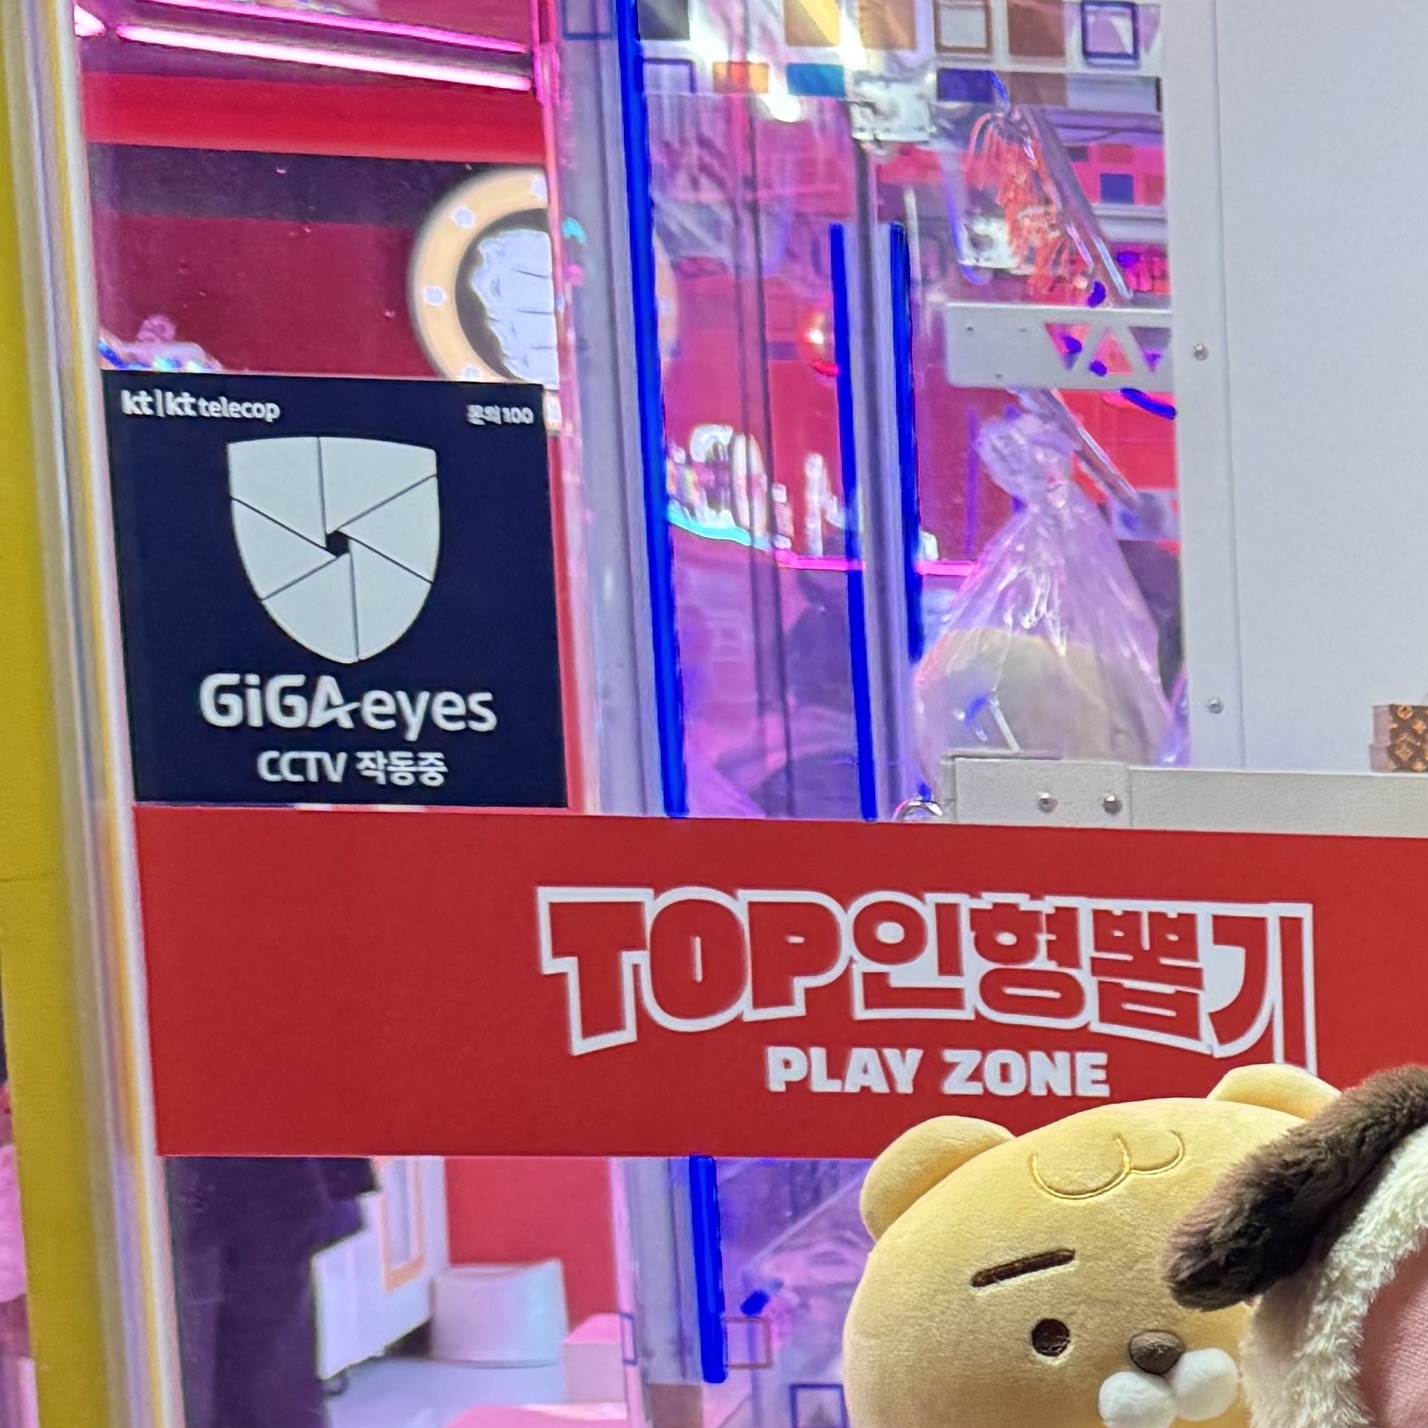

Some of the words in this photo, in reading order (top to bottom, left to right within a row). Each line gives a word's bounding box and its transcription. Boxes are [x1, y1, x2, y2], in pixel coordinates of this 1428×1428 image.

[256, 750, 348, 783] CCTV
[355, 749, 449, 787] 작동중
[765, 1045, 921, 1095] PLAY
[941, 1047, 1111, 1098] ZONE
